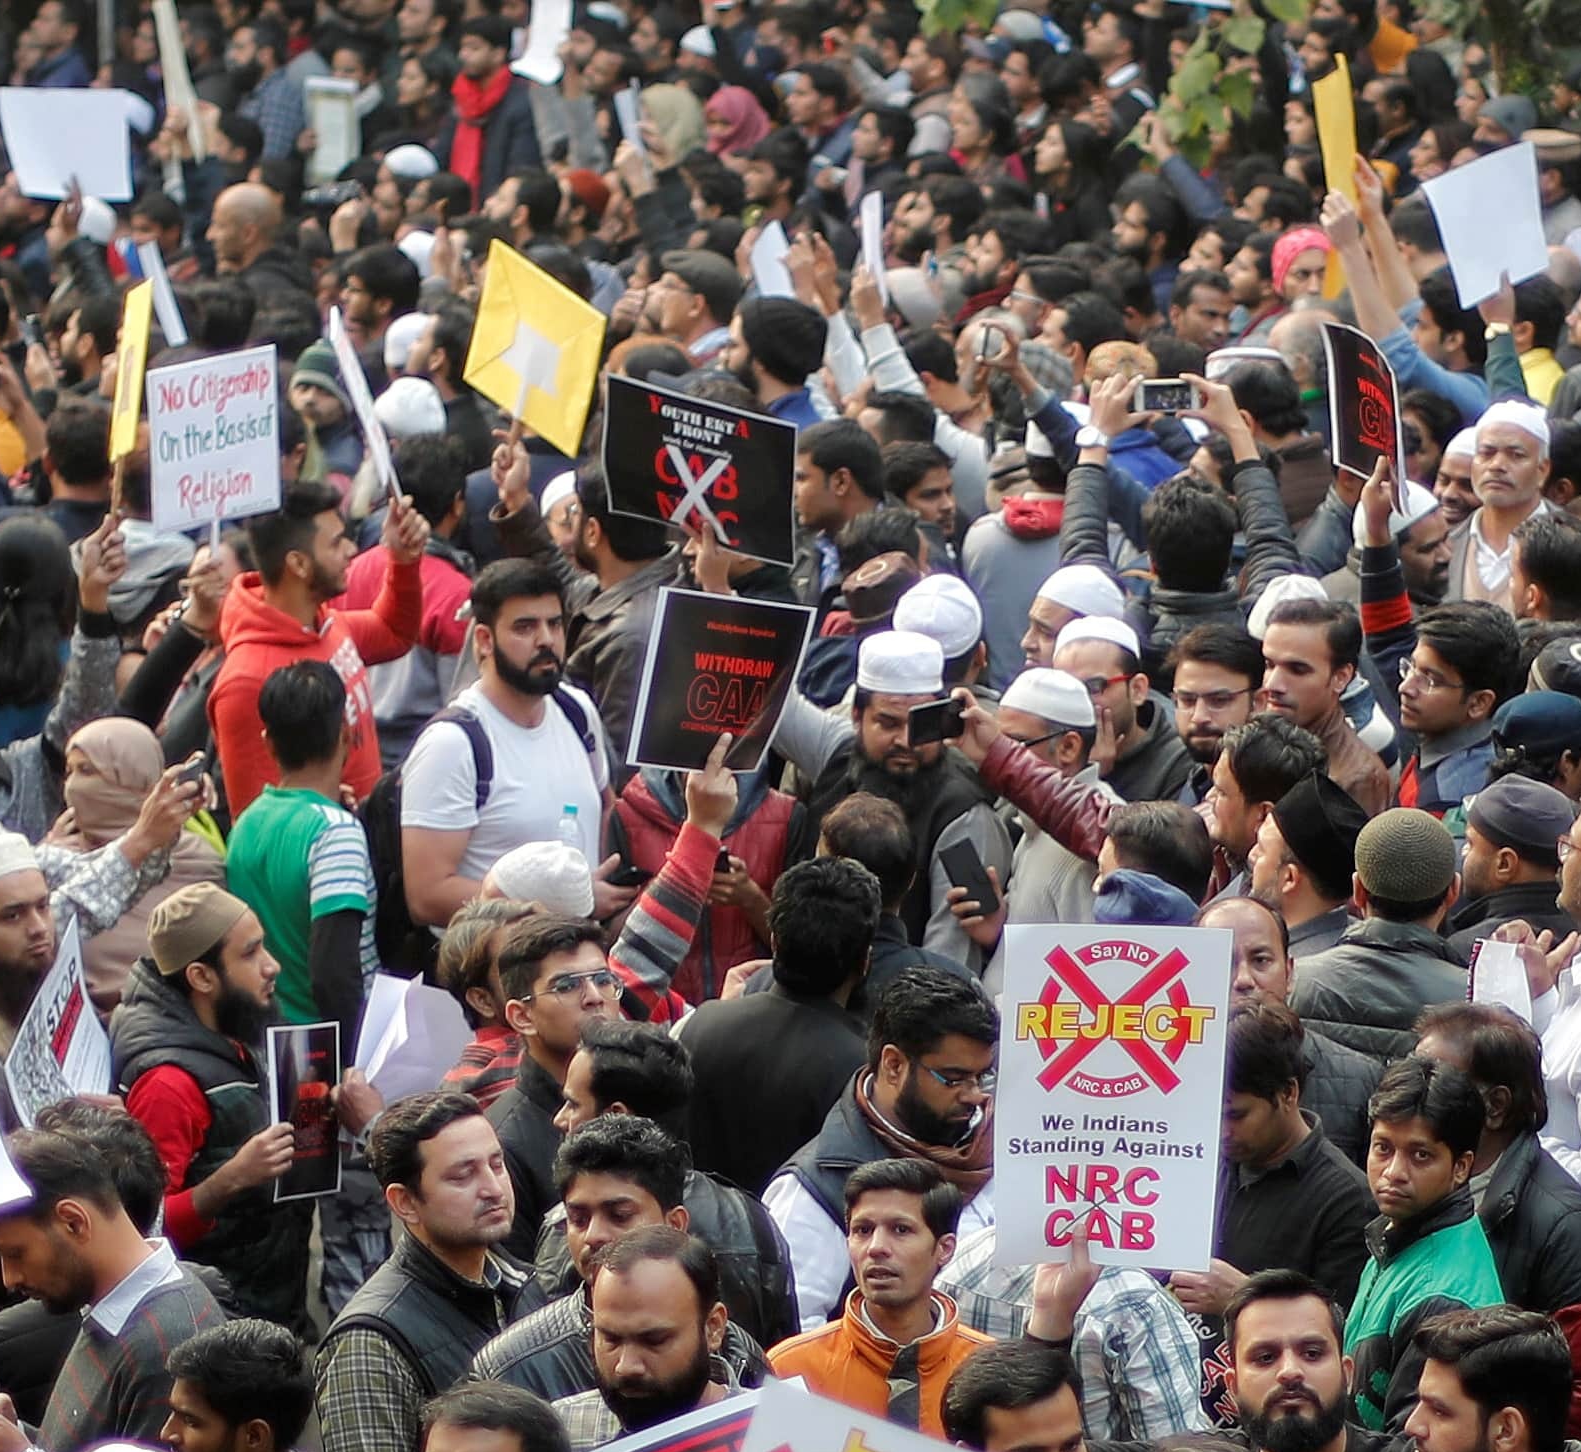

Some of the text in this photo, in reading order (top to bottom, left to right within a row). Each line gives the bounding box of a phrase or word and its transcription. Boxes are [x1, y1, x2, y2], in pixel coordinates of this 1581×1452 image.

[158, 362, 271, 413] No Citizenship
[159, 403, 275, 462] On the Basis of
[673, 421, 724, 446] FRONT
[178, 468, 252, 518] Religion
[654, 447, 739, 500] CAB
[694, 651, 775, 679] WITHDRAW
[687, 672, 766, 725] CAA
[1090, 944, 1150, 963] Say No
[46, 956, 76, 1037] STOP
[1015, 1002, 1216, 1045] REJECT
[1073, 1075, 1142, 1095] NRC & CAB
[1041, 1114, 1169, 1134] We Indians
[1008, 1136, 1204, 1159] Standing Against
[1045, 1163, 1161, 1207] NRC
[1044, 1208, 1156, 1251] CAB
